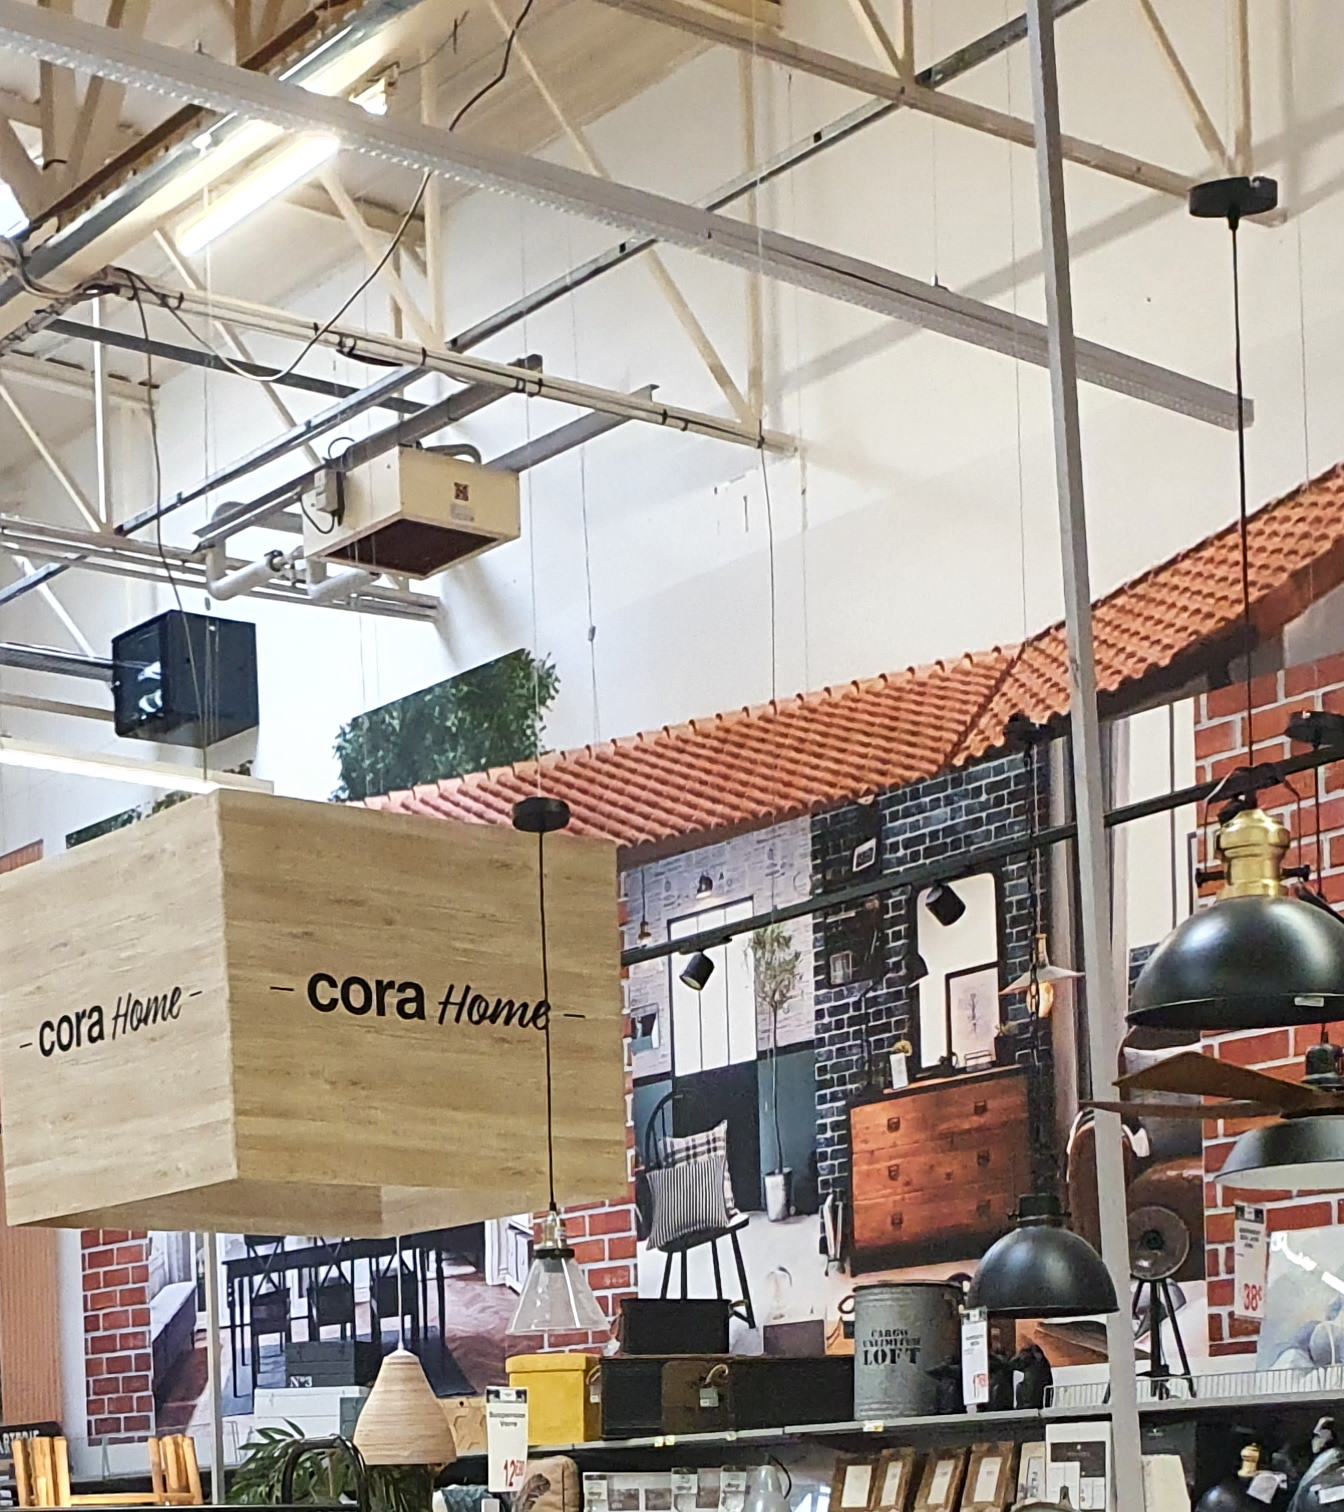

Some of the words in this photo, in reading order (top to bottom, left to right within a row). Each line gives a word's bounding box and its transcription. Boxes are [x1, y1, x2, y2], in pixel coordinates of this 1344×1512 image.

[39, 1005, 105, 1057] cora
[112, 986, 182, 1040] Home
[307, 972, 425, 1021] cora
[438, 984, 550, 1031] Home
[863, 1348, 921, 1365] LOFT
